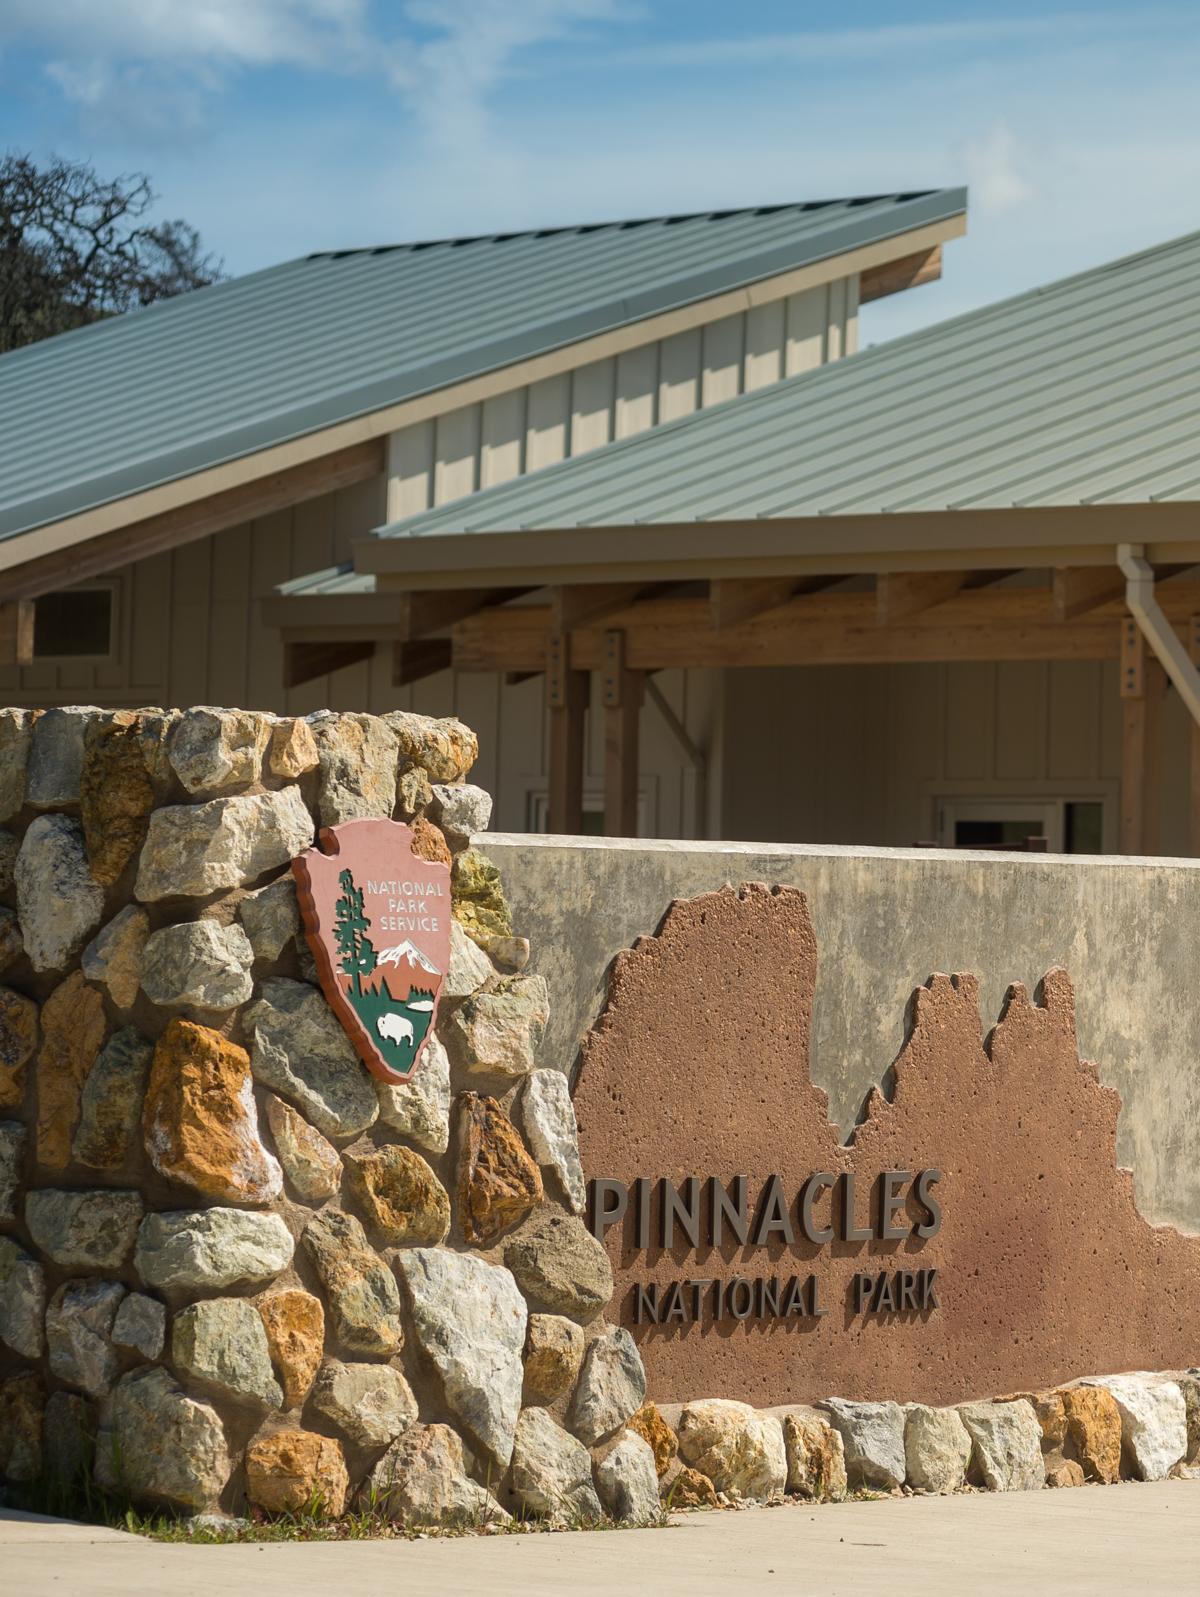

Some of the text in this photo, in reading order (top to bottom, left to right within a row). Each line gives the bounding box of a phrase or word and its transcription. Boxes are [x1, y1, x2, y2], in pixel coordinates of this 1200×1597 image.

[367, 880, 444, 896] NATIONAL
[389, 898, 428, 913] PARK
[380, 916, 440, 931] SERVICE
[592, 1168, 942, 1249] PINNACLES
[635, 1269, 940, 1325] NATIONAL PARK
